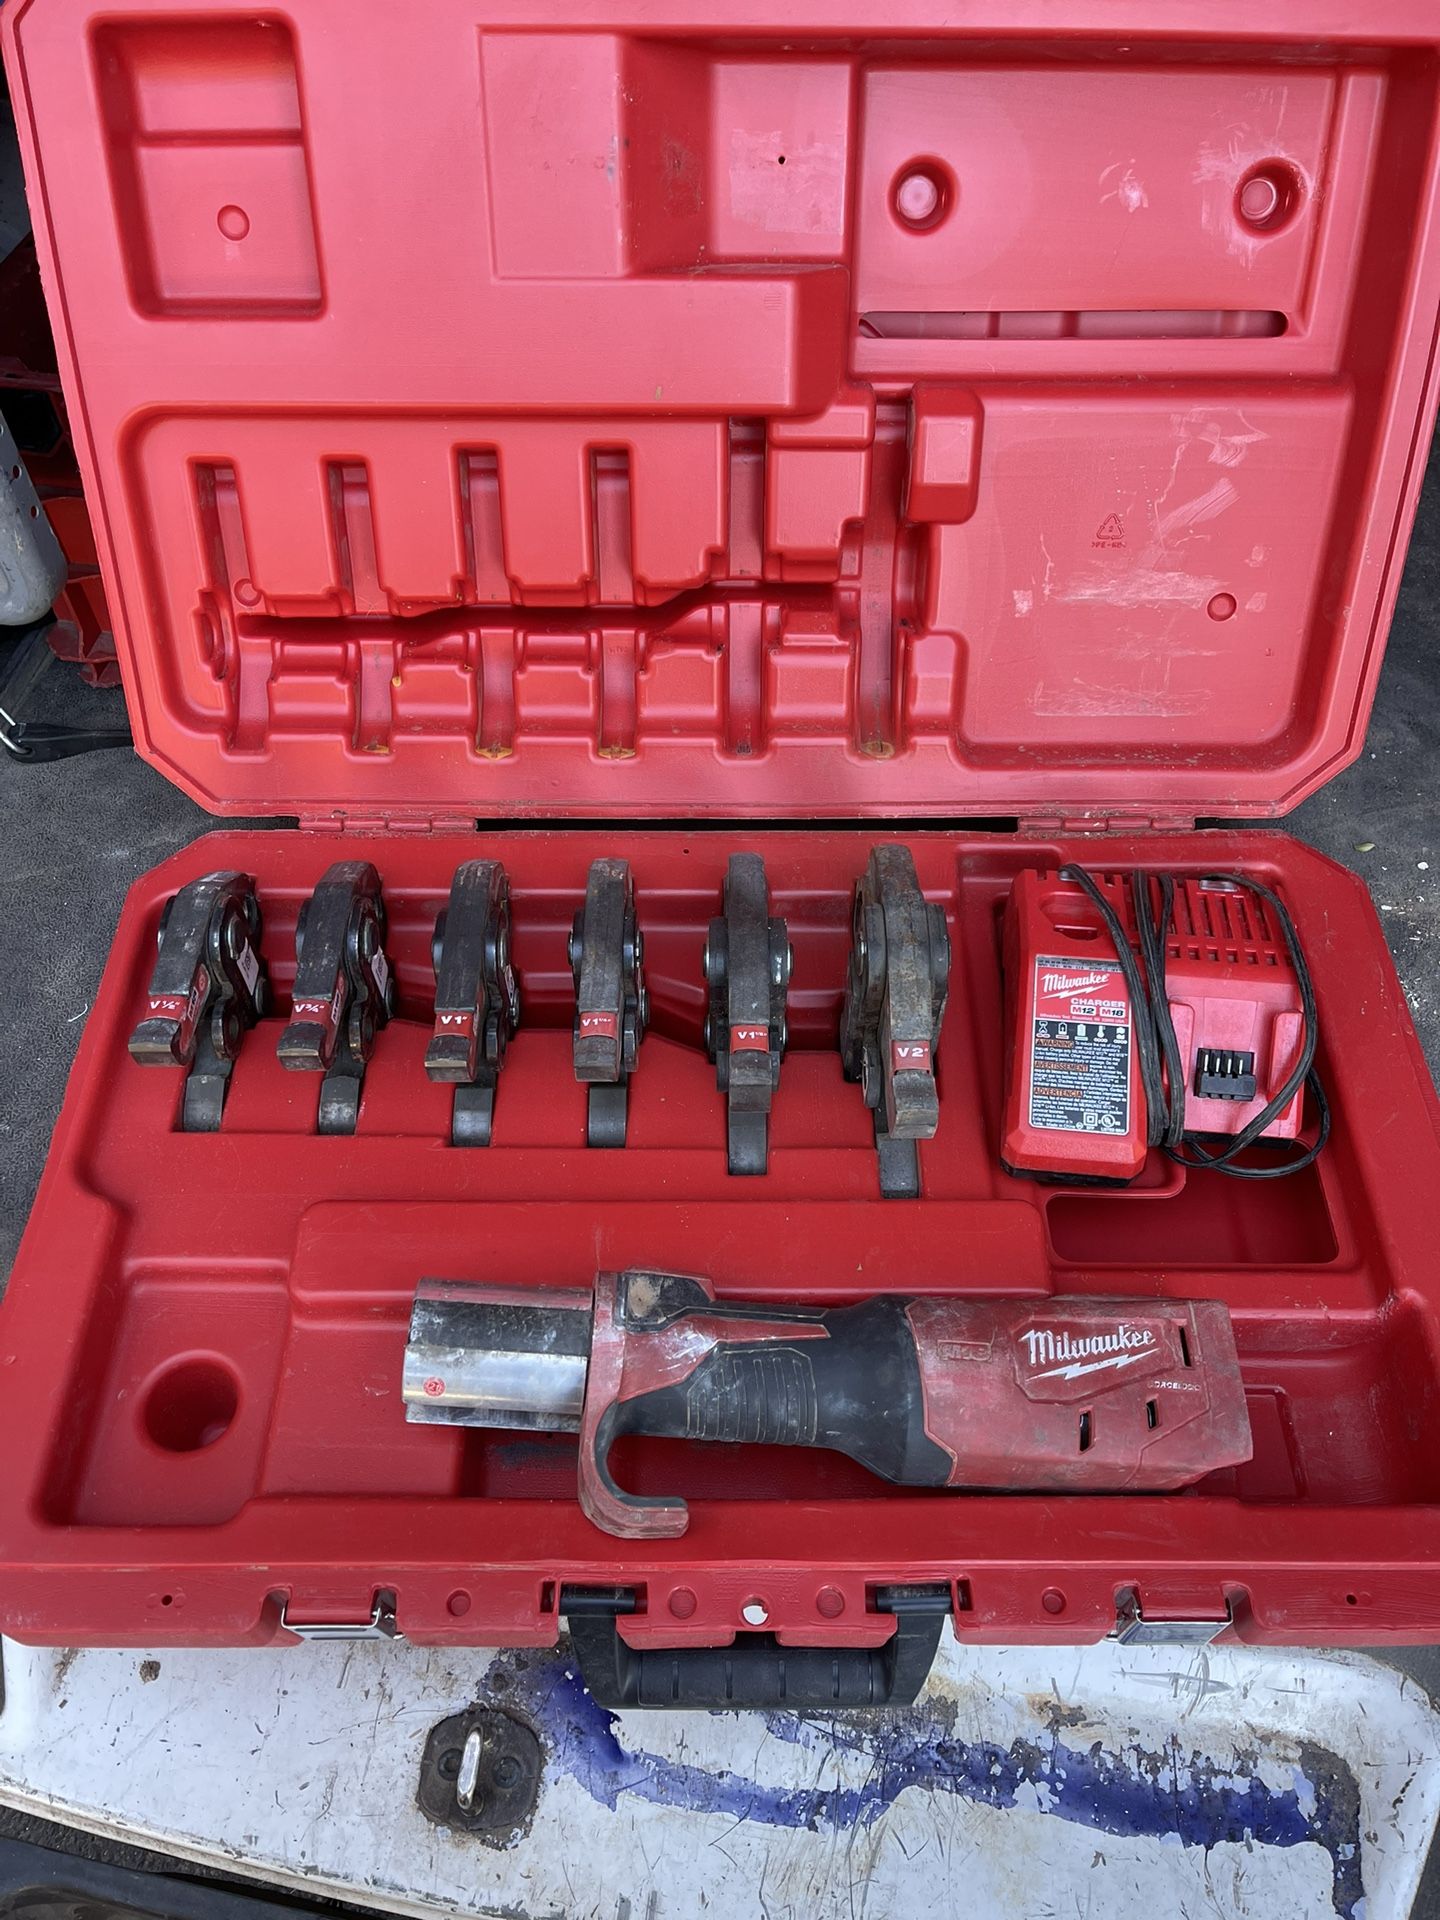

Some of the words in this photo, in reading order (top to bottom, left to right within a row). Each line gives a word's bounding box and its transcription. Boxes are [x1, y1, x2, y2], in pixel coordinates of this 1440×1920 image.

[1041, 972, 1110, 993] Milwaukee
[1070, 998, 1126, 1009] CHARGER
[1072, 1006, 1096, 1015] M12
[1101, 1008, 1124, 1017] M18
[1018, 1324, 1157, 1366] Milwaukee
